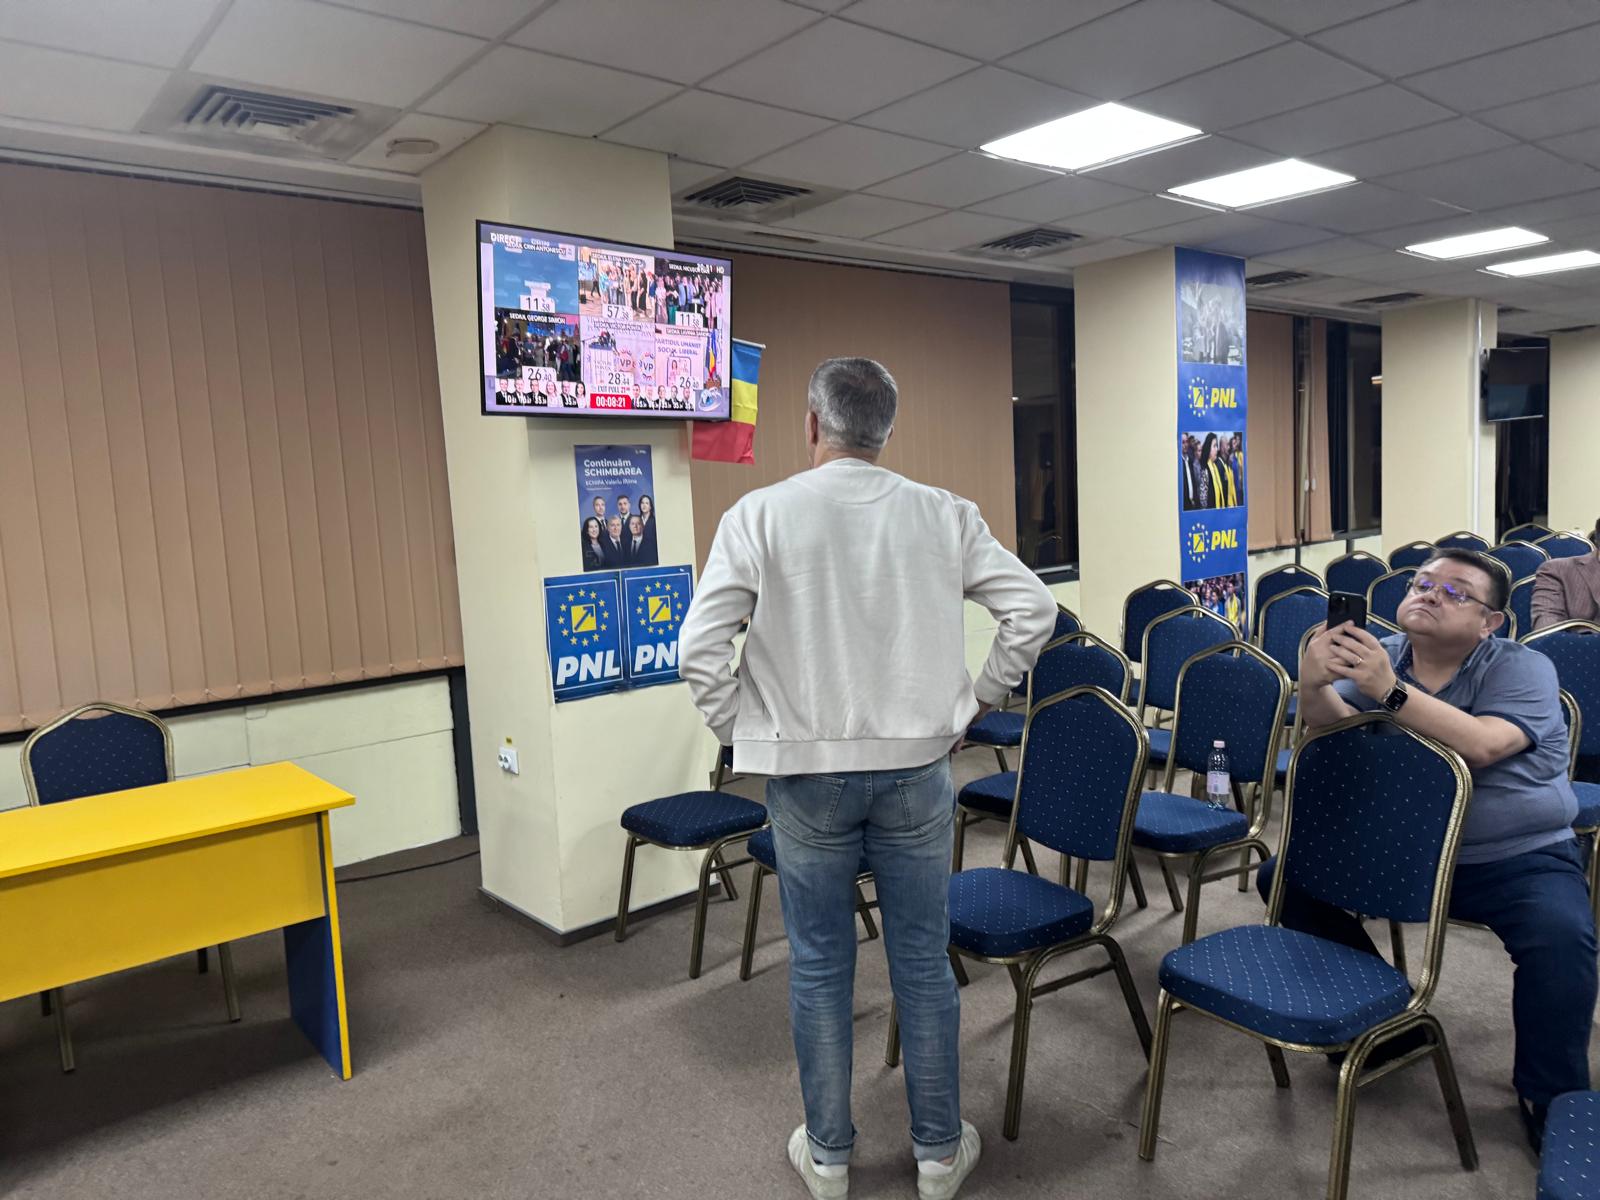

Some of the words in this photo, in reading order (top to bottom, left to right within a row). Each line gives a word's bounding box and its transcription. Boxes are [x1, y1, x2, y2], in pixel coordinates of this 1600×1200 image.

[595, 396, 626, 408] 00:08:21
[1210, 387, 1237, 409] PNL
[583, 458, 632, 467] Continuăm
[584, 467, 643, 477] SCHIMBAREA
[1211, 529, 1238, 551] PNL
[556, 649, 621, 685] PNL
[634, 640, 680, 672] PN
